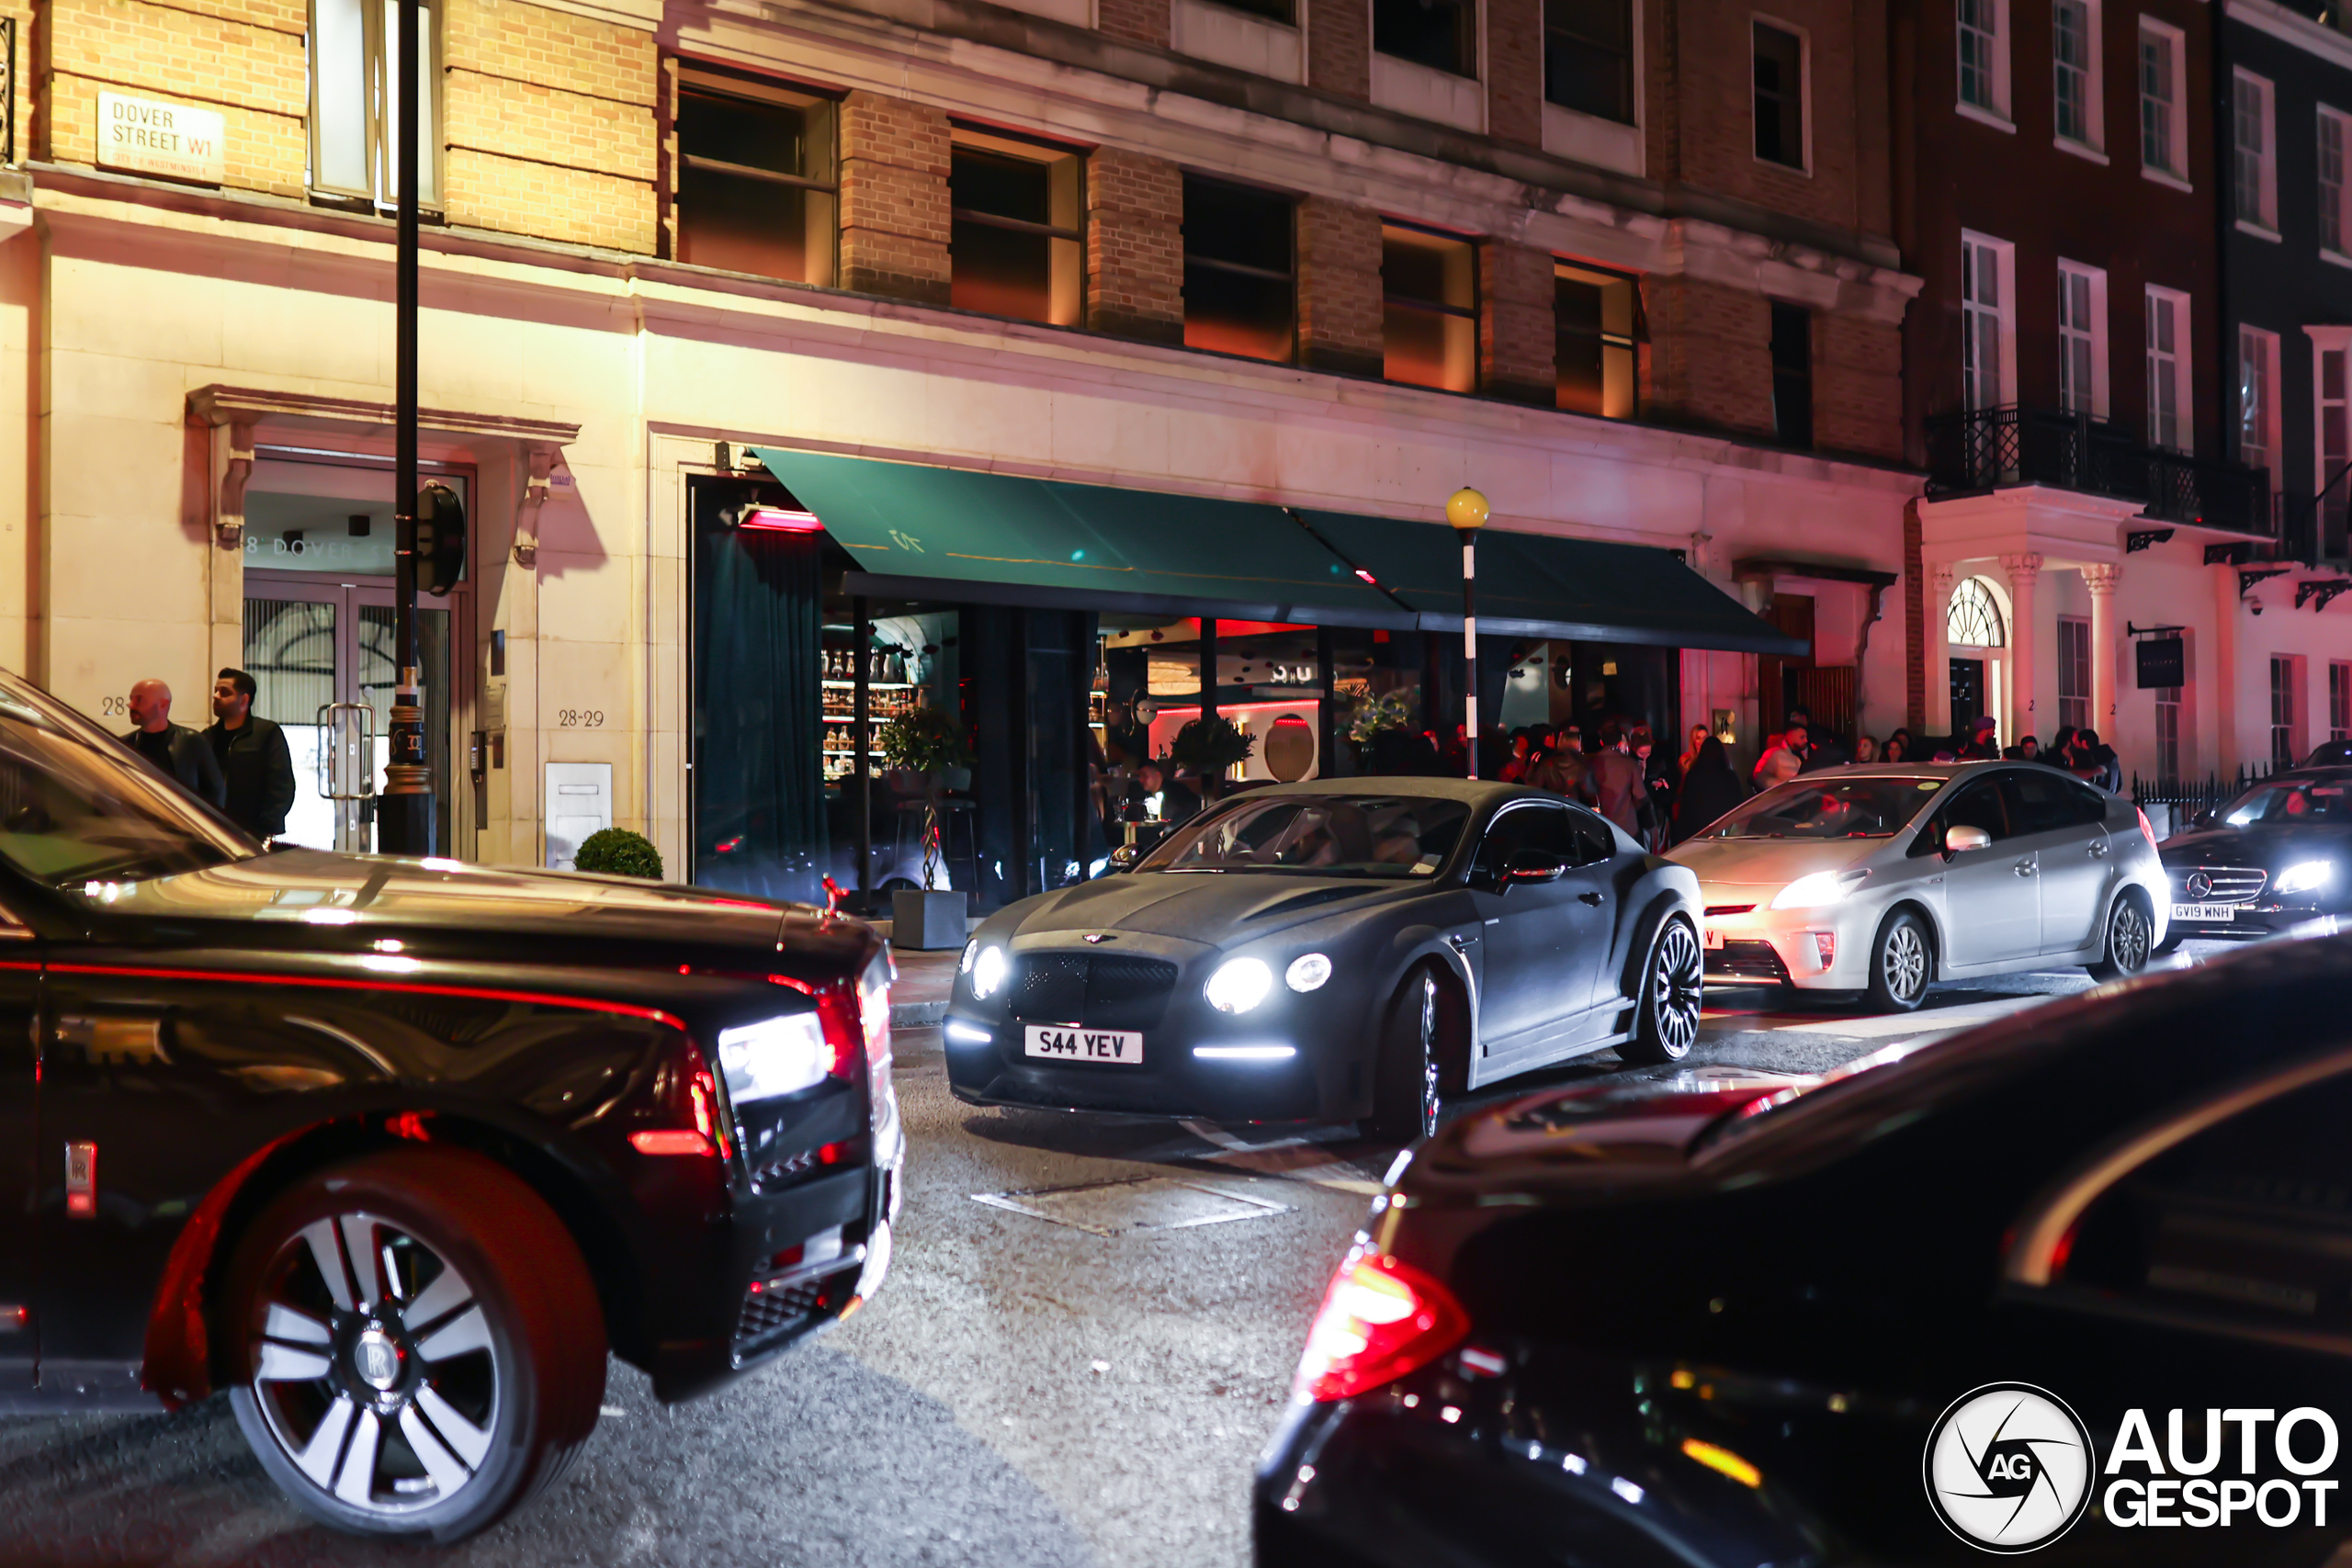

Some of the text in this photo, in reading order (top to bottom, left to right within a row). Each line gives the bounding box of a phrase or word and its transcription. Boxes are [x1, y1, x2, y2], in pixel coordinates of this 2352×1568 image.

[113, 102, 173, 128] DOVER
[113, 124, 211, 157] STREET W1
[246, 536, 258, 553] 8
[274, 538, 354, 559] DOVER
[559, 709, 605, 727] 28-29
[2176, 906, 2229, 918] GV19 WNH
[1040, 1031, 1125, 1058] S44 YEV
